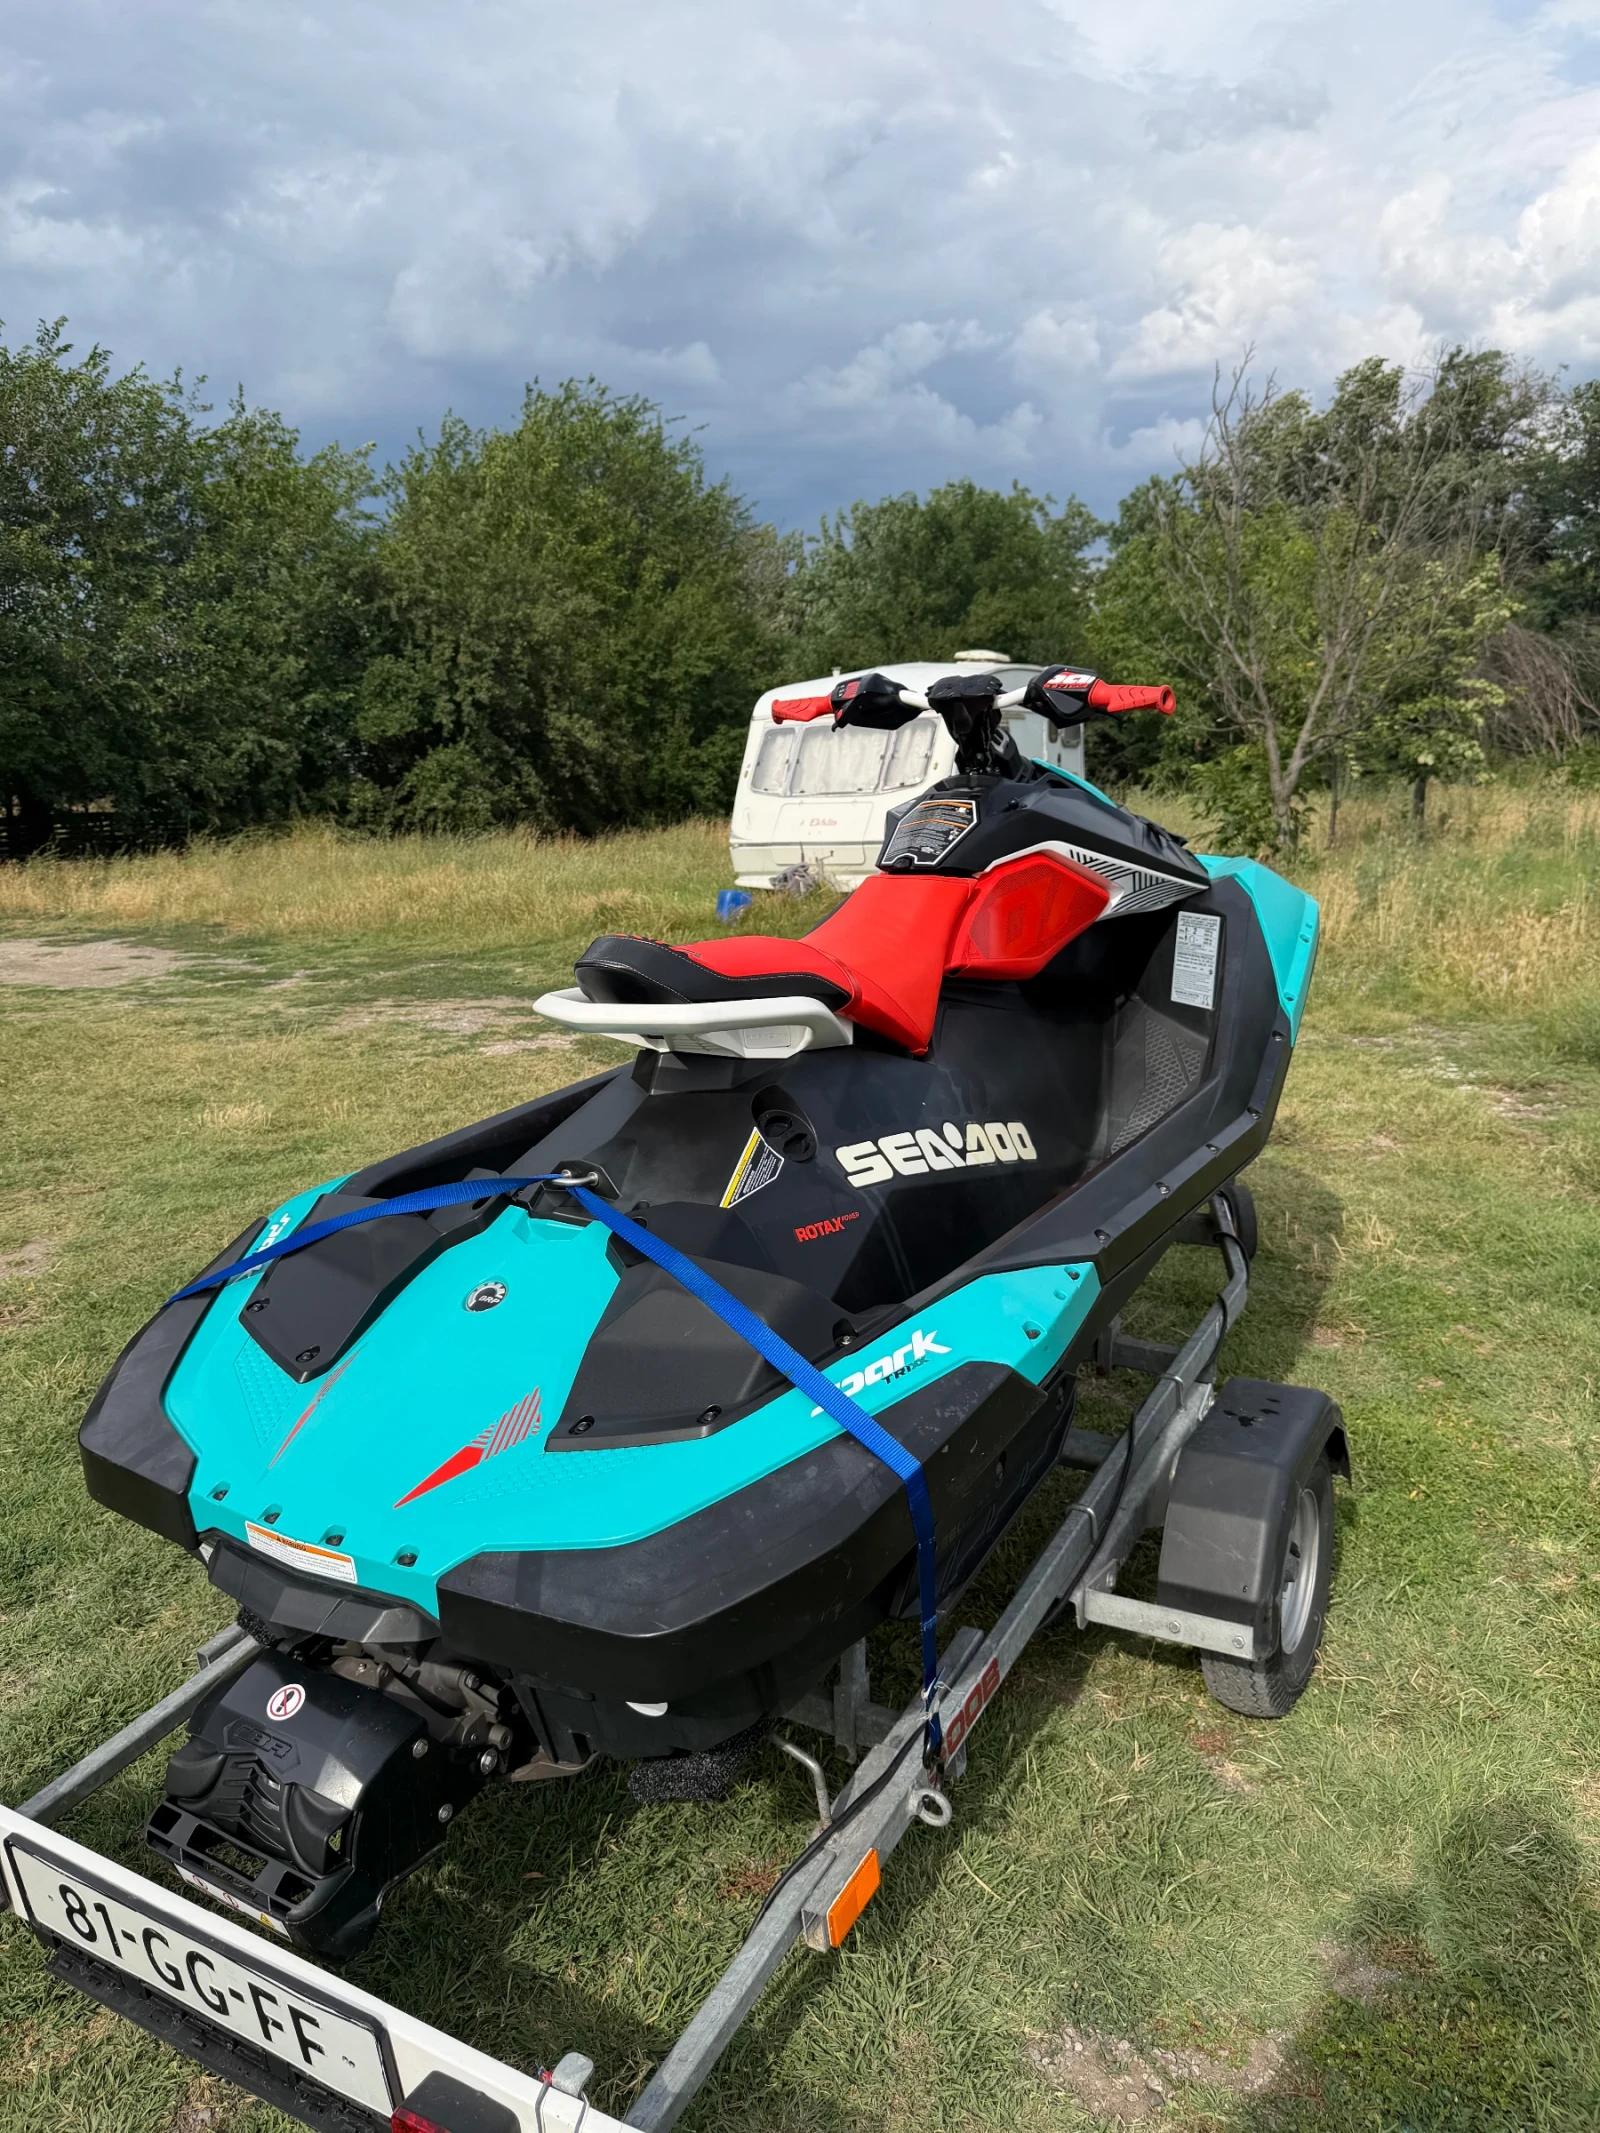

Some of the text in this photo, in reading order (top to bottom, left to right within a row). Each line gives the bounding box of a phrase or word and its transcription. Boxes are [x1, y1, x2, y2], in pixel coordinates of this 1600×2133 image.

[795, 1211, 860, 1242] ROTAX POWER
[478, 1295, 501, 1304] BRP
[810, 1329, 953, 1418] park
[58, 1883, 326, 2067] 81-GG-FF
